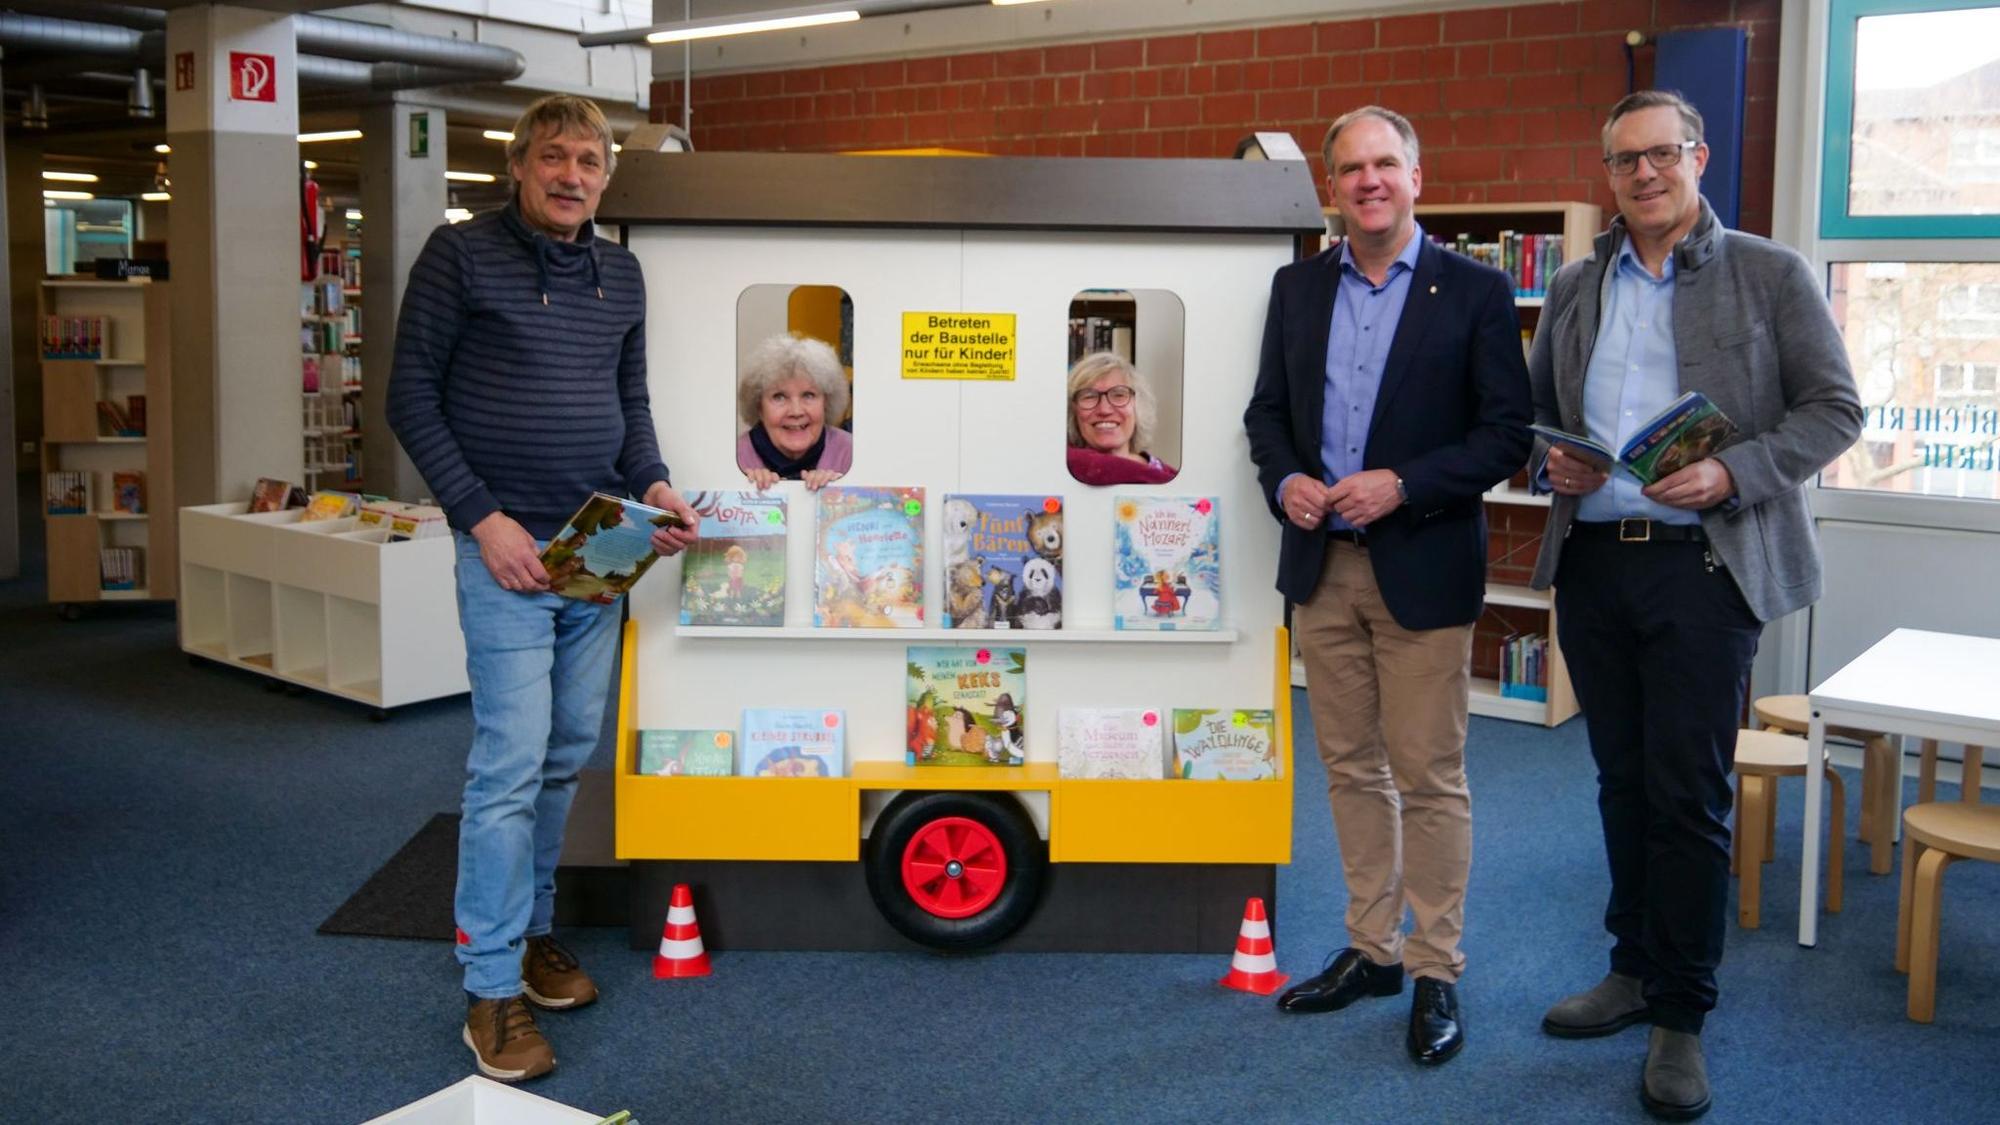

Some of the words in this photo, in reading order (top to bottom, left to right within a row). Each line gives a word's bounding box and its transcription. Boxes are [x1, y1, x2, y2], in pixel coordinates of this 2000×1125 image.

[928, 316, 990, 329] Betreten
[910, 331, 934, 343] der
[939, 332, 1008, 345] Baustelle
[904, 349, 929, 359] nur
[934, 347, 954, 359] für
[959, 348, 1013, 360] Kinder!
[716, 506, 758, 526] LOTTA
[1139, 519, 1192, 534] Nannerl
[973, 533, 1030, 552] Bären
[1143, 532, 1190, 547] Mozart
[957, 671, 1002, 690] KEKS
[1205, 720, 1227, 735] DIE
